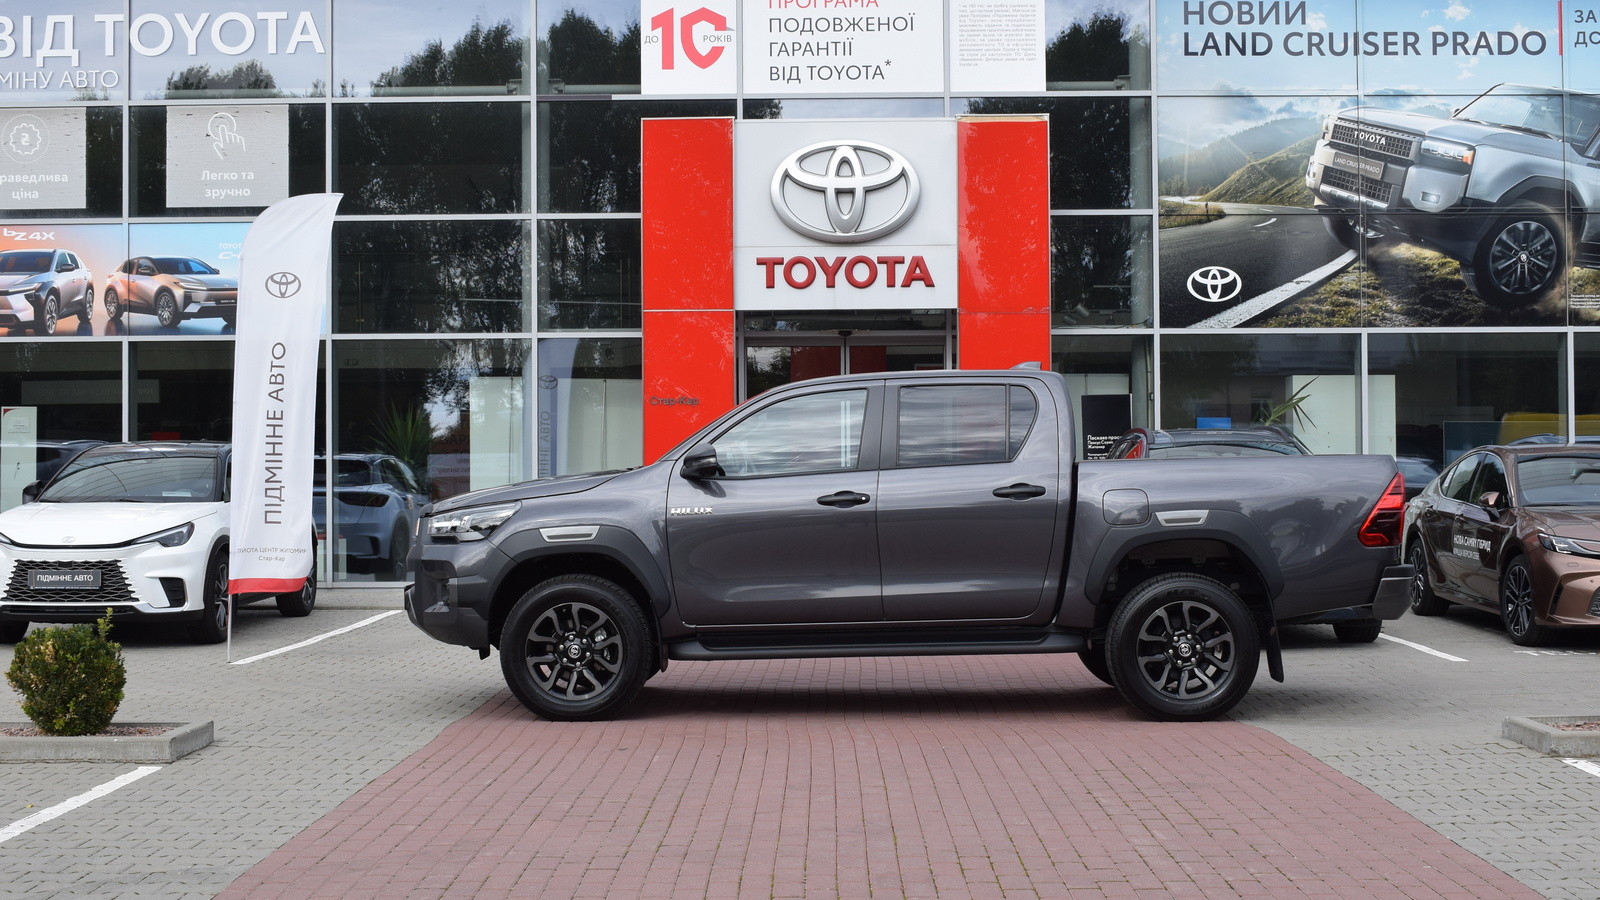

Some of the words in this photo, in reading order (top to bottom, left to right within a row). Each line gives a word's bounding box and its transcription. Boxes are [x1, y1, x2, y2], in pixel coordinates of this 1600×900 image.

[769, 12, 916, 36] ПОДОВЖЕНОЇ
[94, 11, 326, 56] TOYOTA
[644, 35, 659, 44] ДО
[703, 34, 732, 43] РОКІВ
[769, 37, 854, 57] ГАРАНТІЇ
[1183, 31, 1273, 56] LAND
[1283, 31, 1421, 56] CRUISER
[1432, 31, 1547, 56] PRADO
[59, 70, 119, 88] АВТО
[769, 66, 801, 84] ВІД
[1354, 131, 1386, 145] TOYOTA
[1334, 157, 1346, 165] LAND
[1365, 164, 1380, 173] PRADO
[201, 170, 238, 180] Легко
[241, 171, 254, 180] та
[12, 188, 39, 200] ціна
[205, 188, 251, 199] зручно
[756, 255, 935, 289] TOYOTA
[268, 342, 286, 402] АВТО
[650, 396, 699, 407] Стар-Кар
[264, 410, 285, 524] ПІДМІННЕ
[670, 507, 713, 515] HILUX
